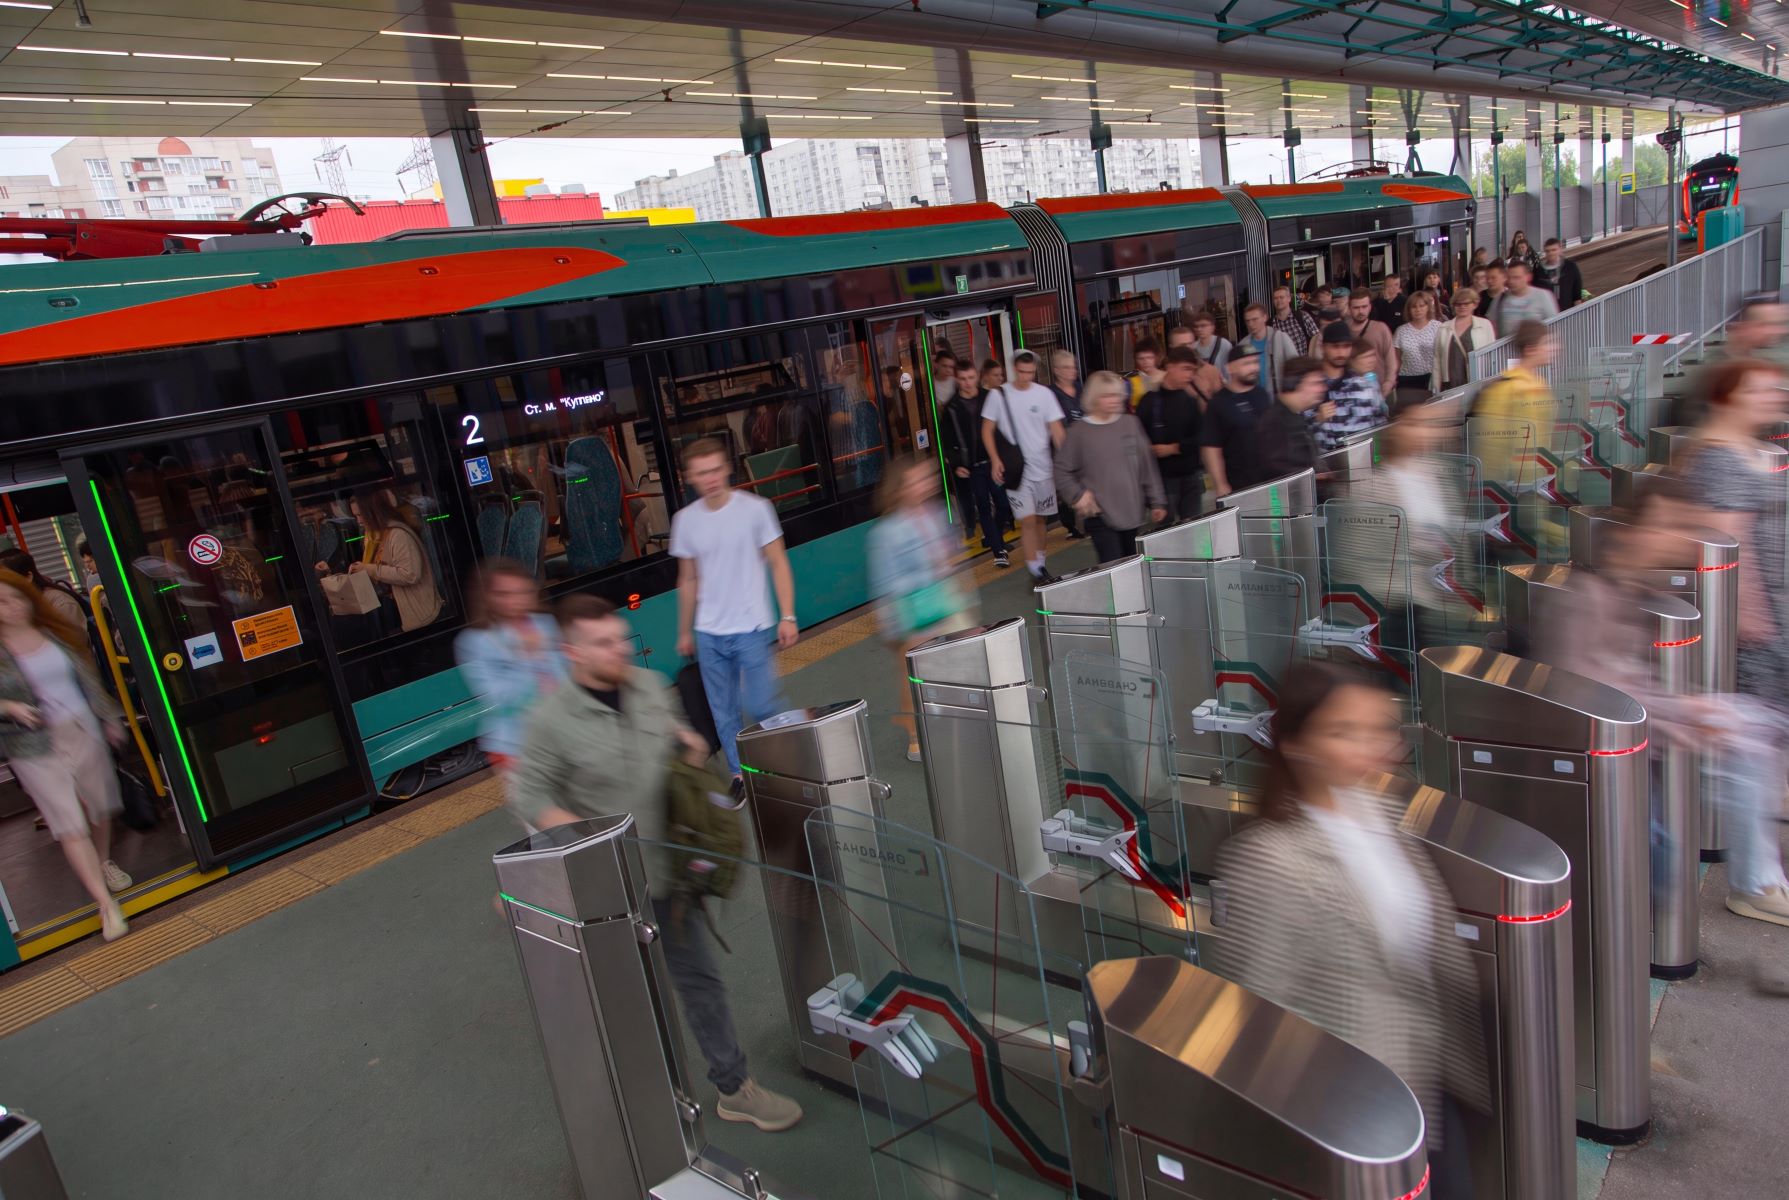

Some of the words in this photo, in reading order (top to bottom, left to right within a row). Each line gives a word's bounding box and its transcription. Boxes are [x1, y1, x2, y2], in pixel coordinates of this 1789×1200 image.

[524, 404, 542, 416] Ст.
[545, 402, 557, 412] м.
[462, 415, 485, 445] 2
